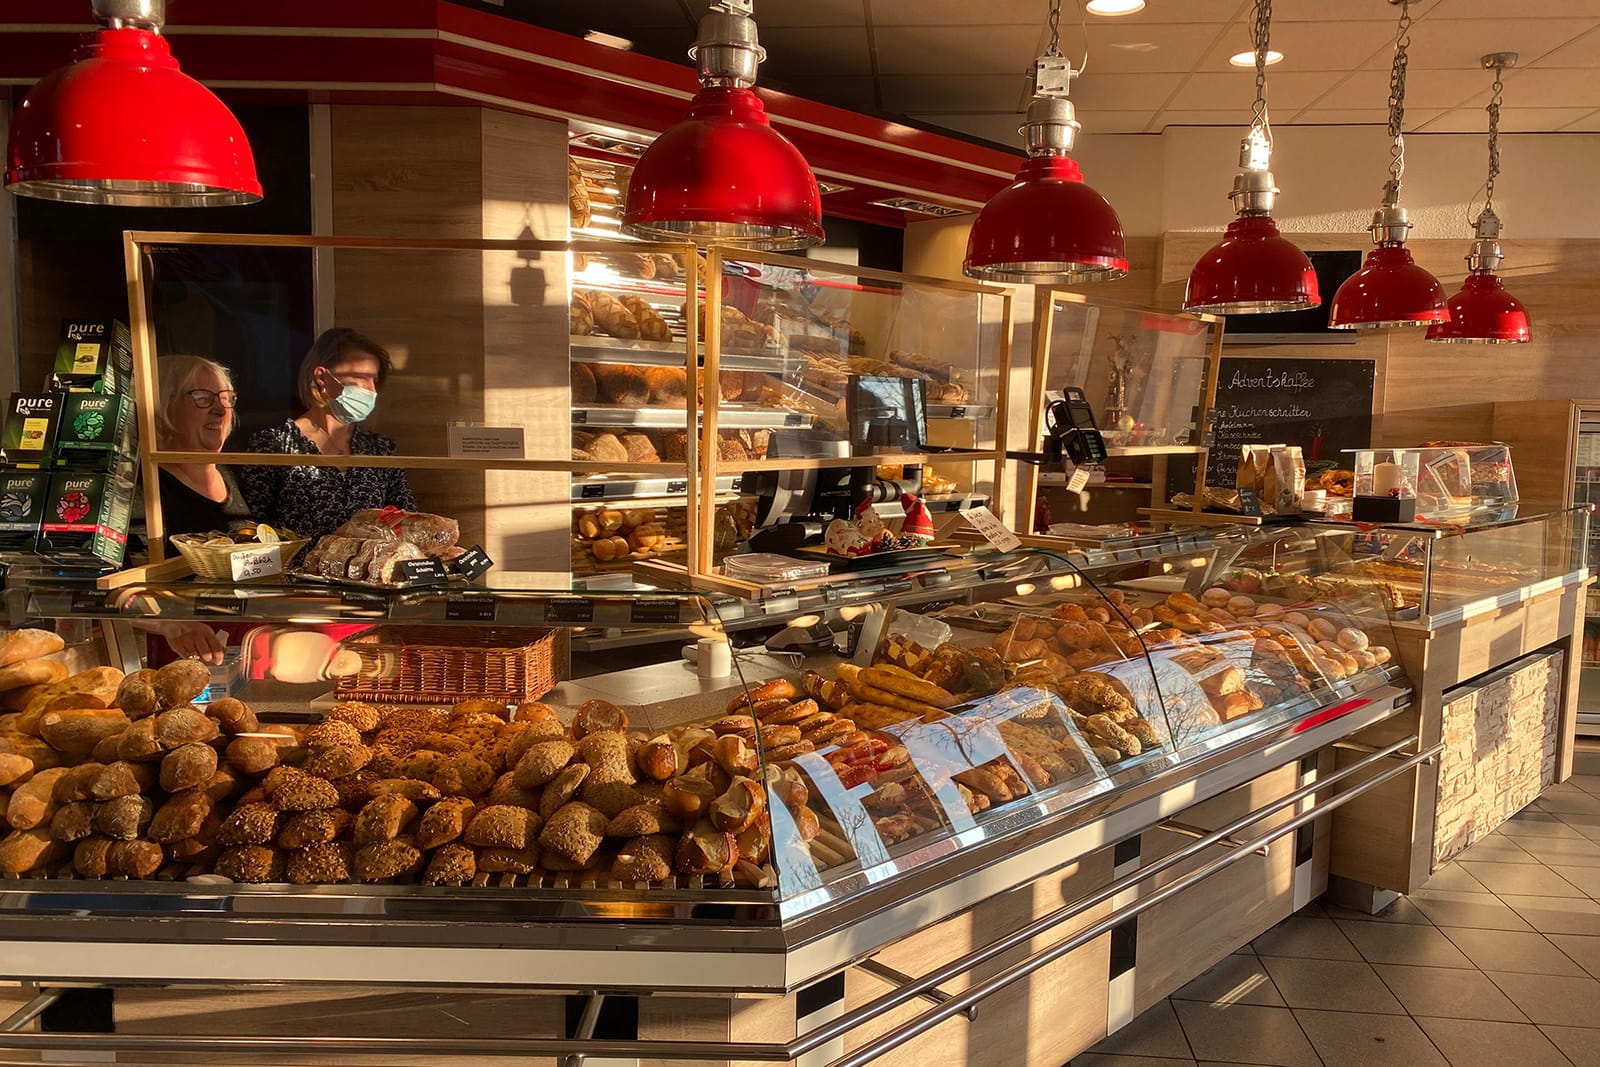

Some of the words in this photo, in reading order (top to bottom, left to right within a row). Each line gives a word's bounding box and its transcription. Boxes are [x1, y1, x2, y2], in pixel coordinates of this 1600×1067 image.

[68, 323, 104, 338] pure
[1227, 368, 1316, 395] Adventskaffee
[16, 398, 53, 413] pure
[80, 399, 106, 410] pure
[7, 478, 34, 490] pure
[64, 479, 91, 491] pure
